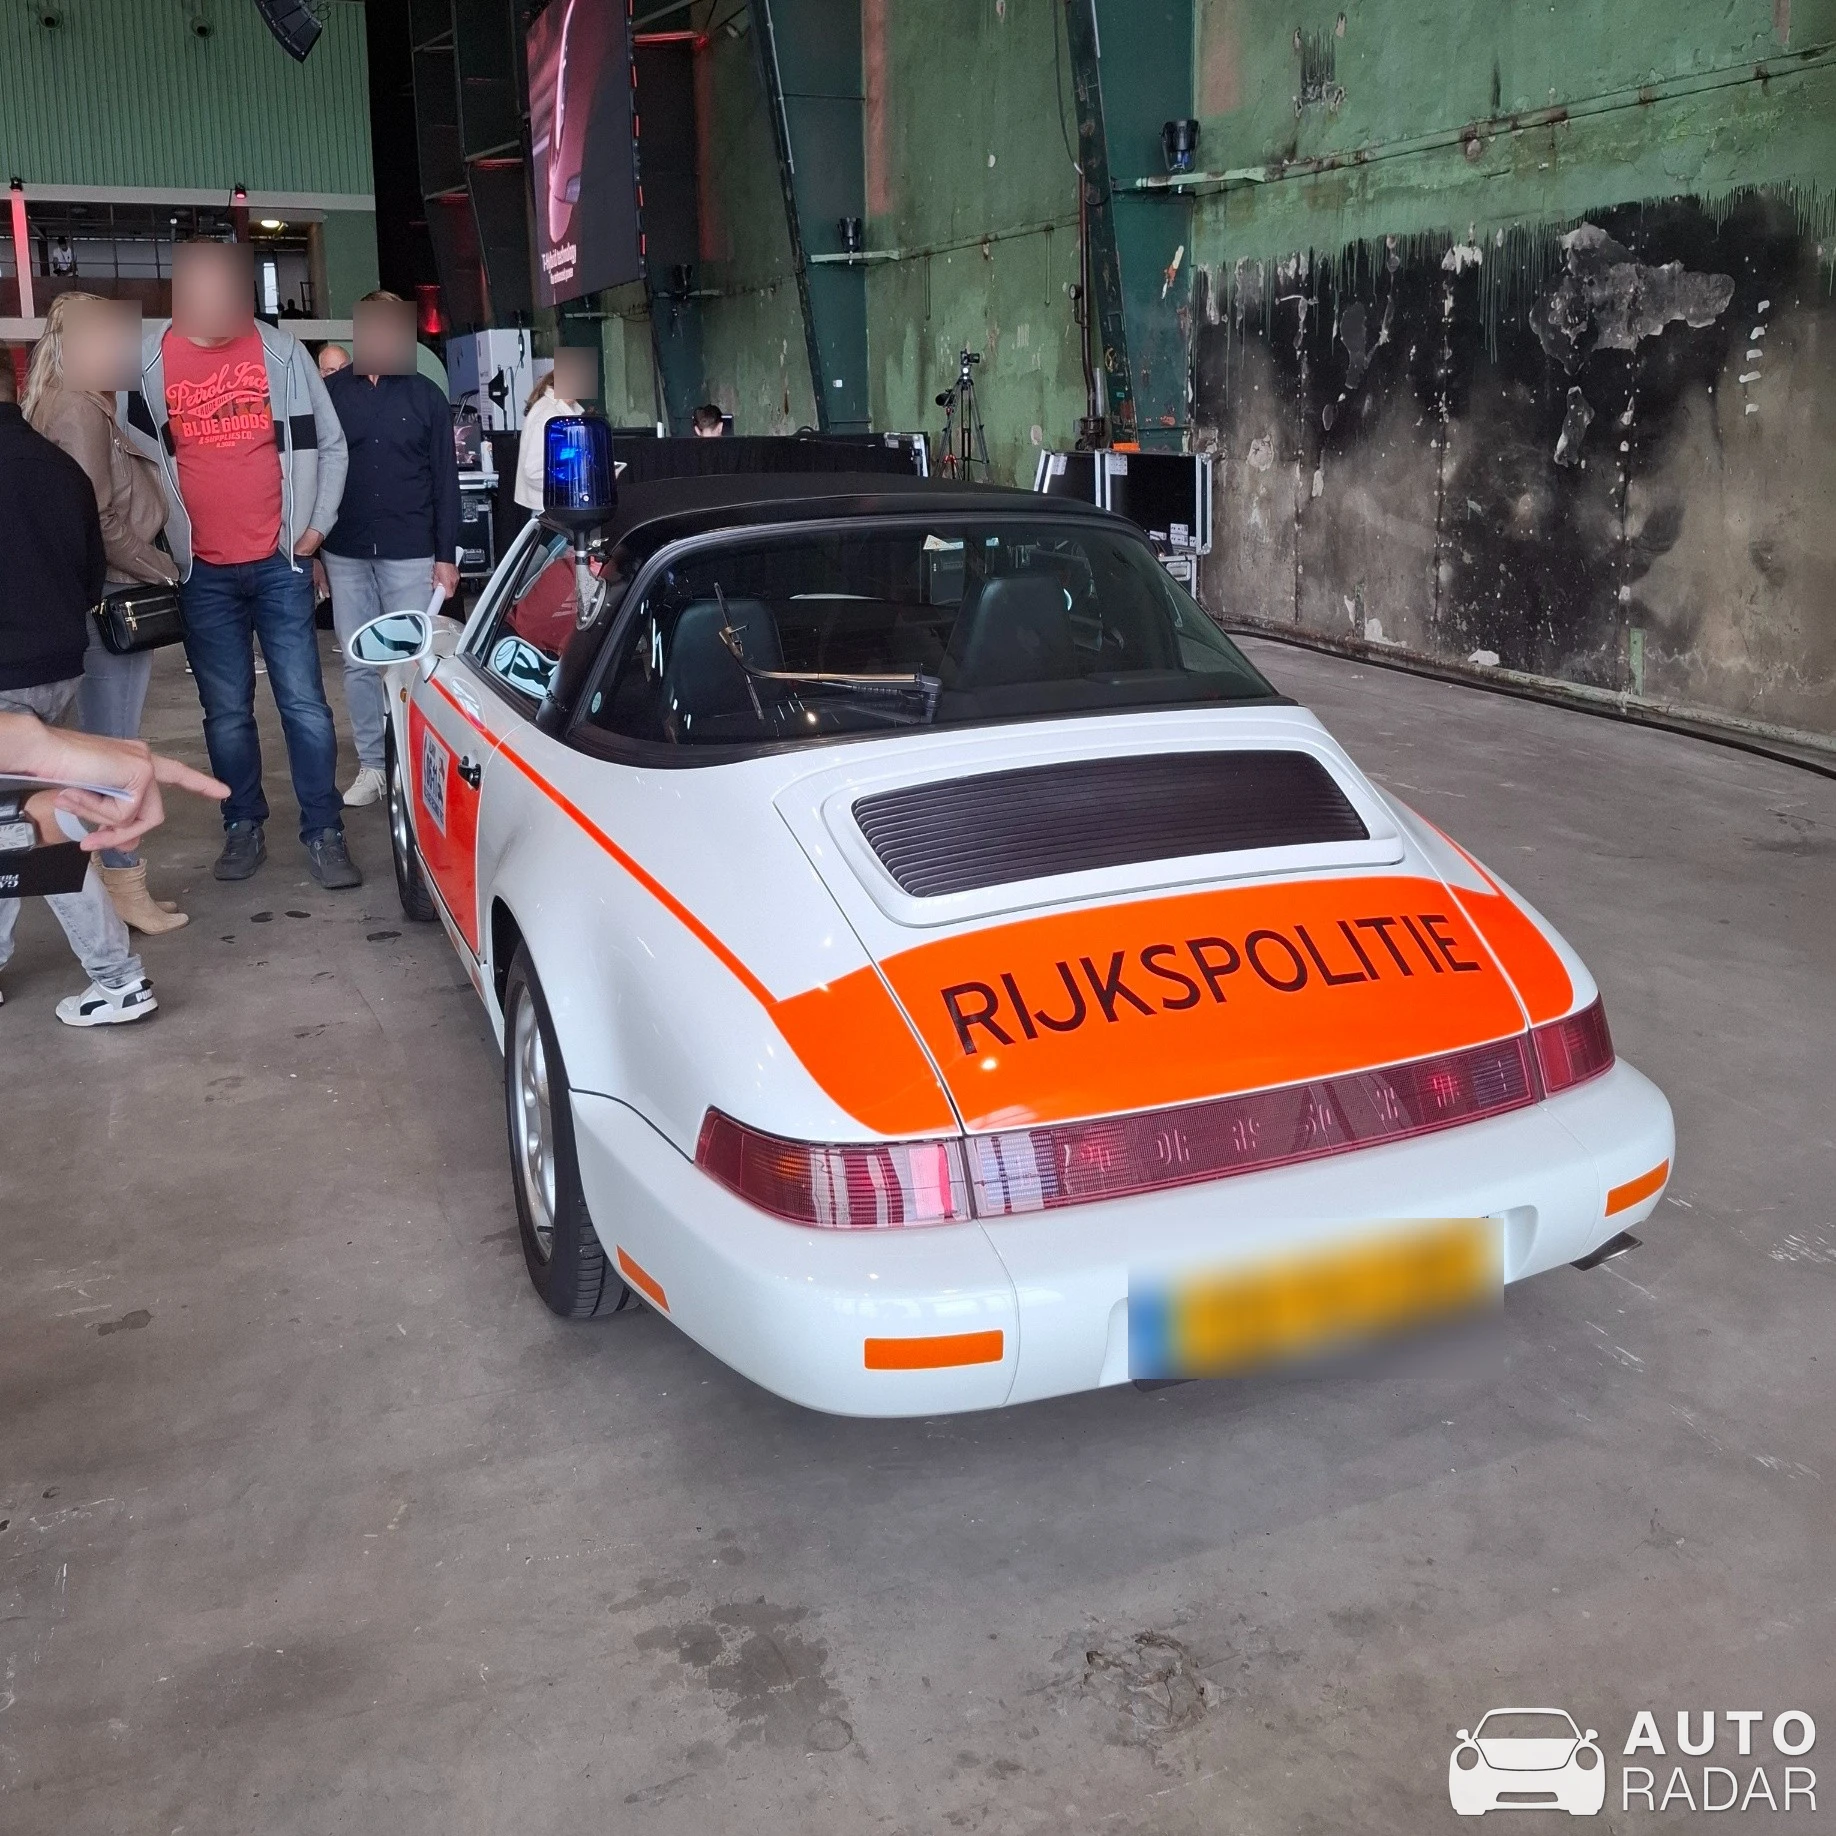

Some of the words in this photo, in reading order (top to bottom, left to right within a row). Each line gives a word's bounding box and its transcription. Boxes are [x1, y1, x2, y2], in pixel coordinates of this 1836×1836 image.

[166, 364, 230, 415] Petrol
[182, 418, 220, 437] BLUE
[221, 413, 269, 432] GOODS
[941, 914, 1482, 1056] RIJKSPOLITIE
